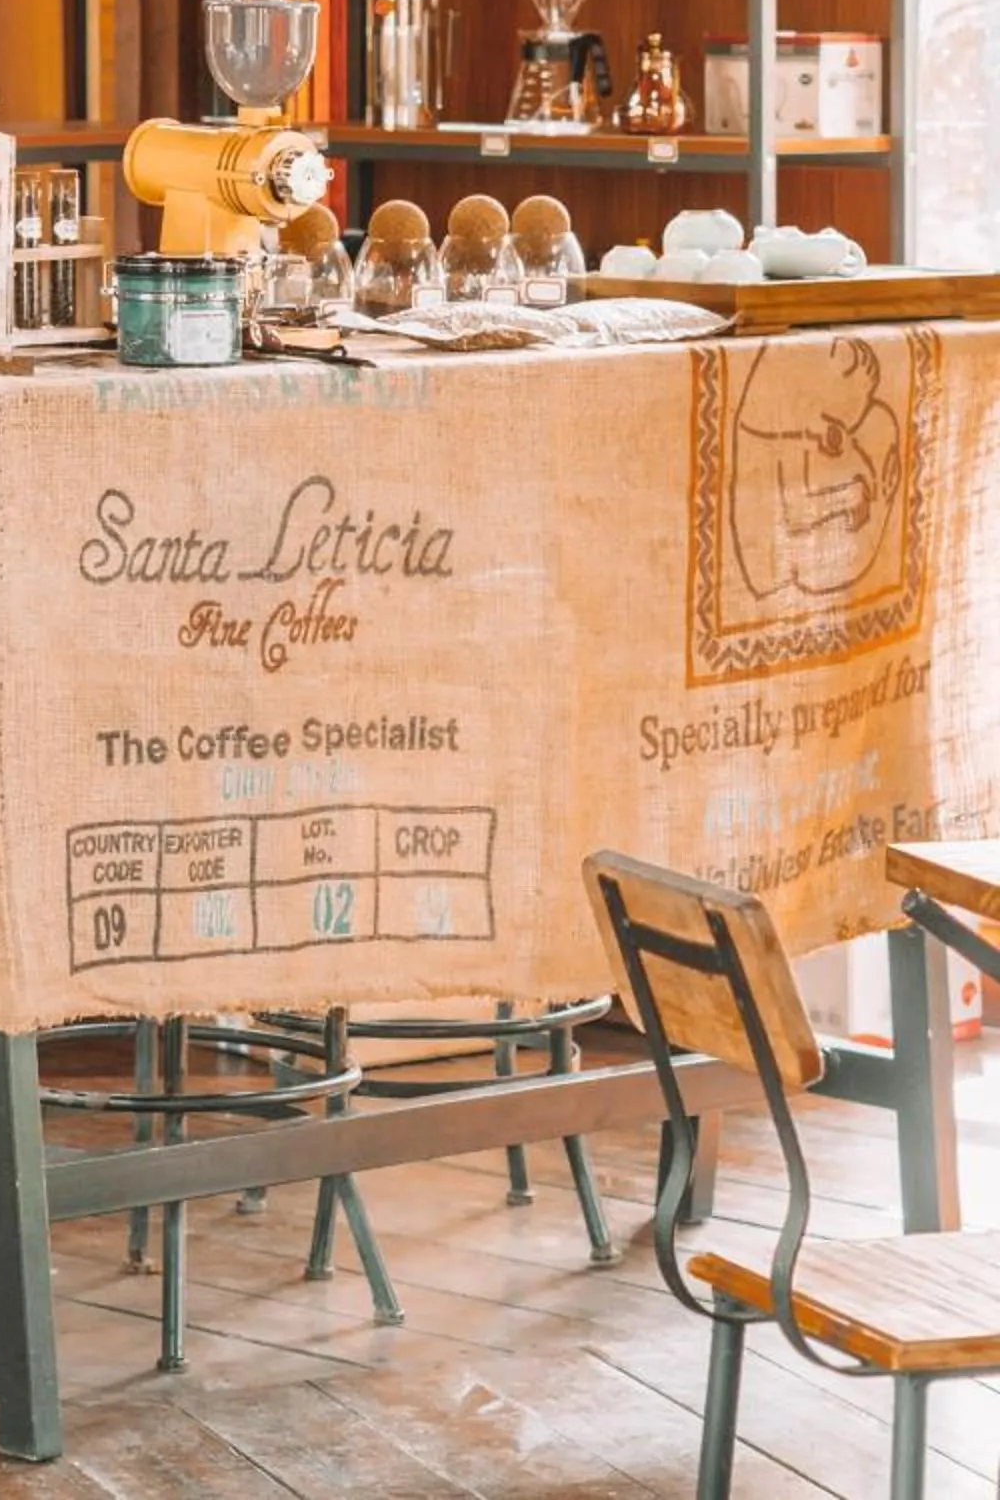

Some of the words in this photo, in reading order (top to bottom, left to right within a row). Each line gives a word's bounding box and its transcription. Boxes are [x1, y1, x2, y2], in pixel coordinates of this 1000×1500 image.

[80, 489, 231, 585] Santa
[237, 475, 454, 583] Leticia
[178, 600, 252, 649] Fine
[261, 577, 358, 673] Coffees
[639, 699, 784, 772] Specially
[891, 655, 931, 703] for
[96, 729, 167, 767] The
[176, 725, 292, 762] Coffee
[302, 714, 460, 757] Specialist
[72, 831, 156, 858] COUNTRY
[165, 828, 243, 854] EXPORTER
[395, 825, 461, 858] CROP
[93, 859, 143, 884] CODE
[188, 856, 226, 883] CODE
[94, 903, 126, 951] 09
[313, 882, 355, 936] 02
